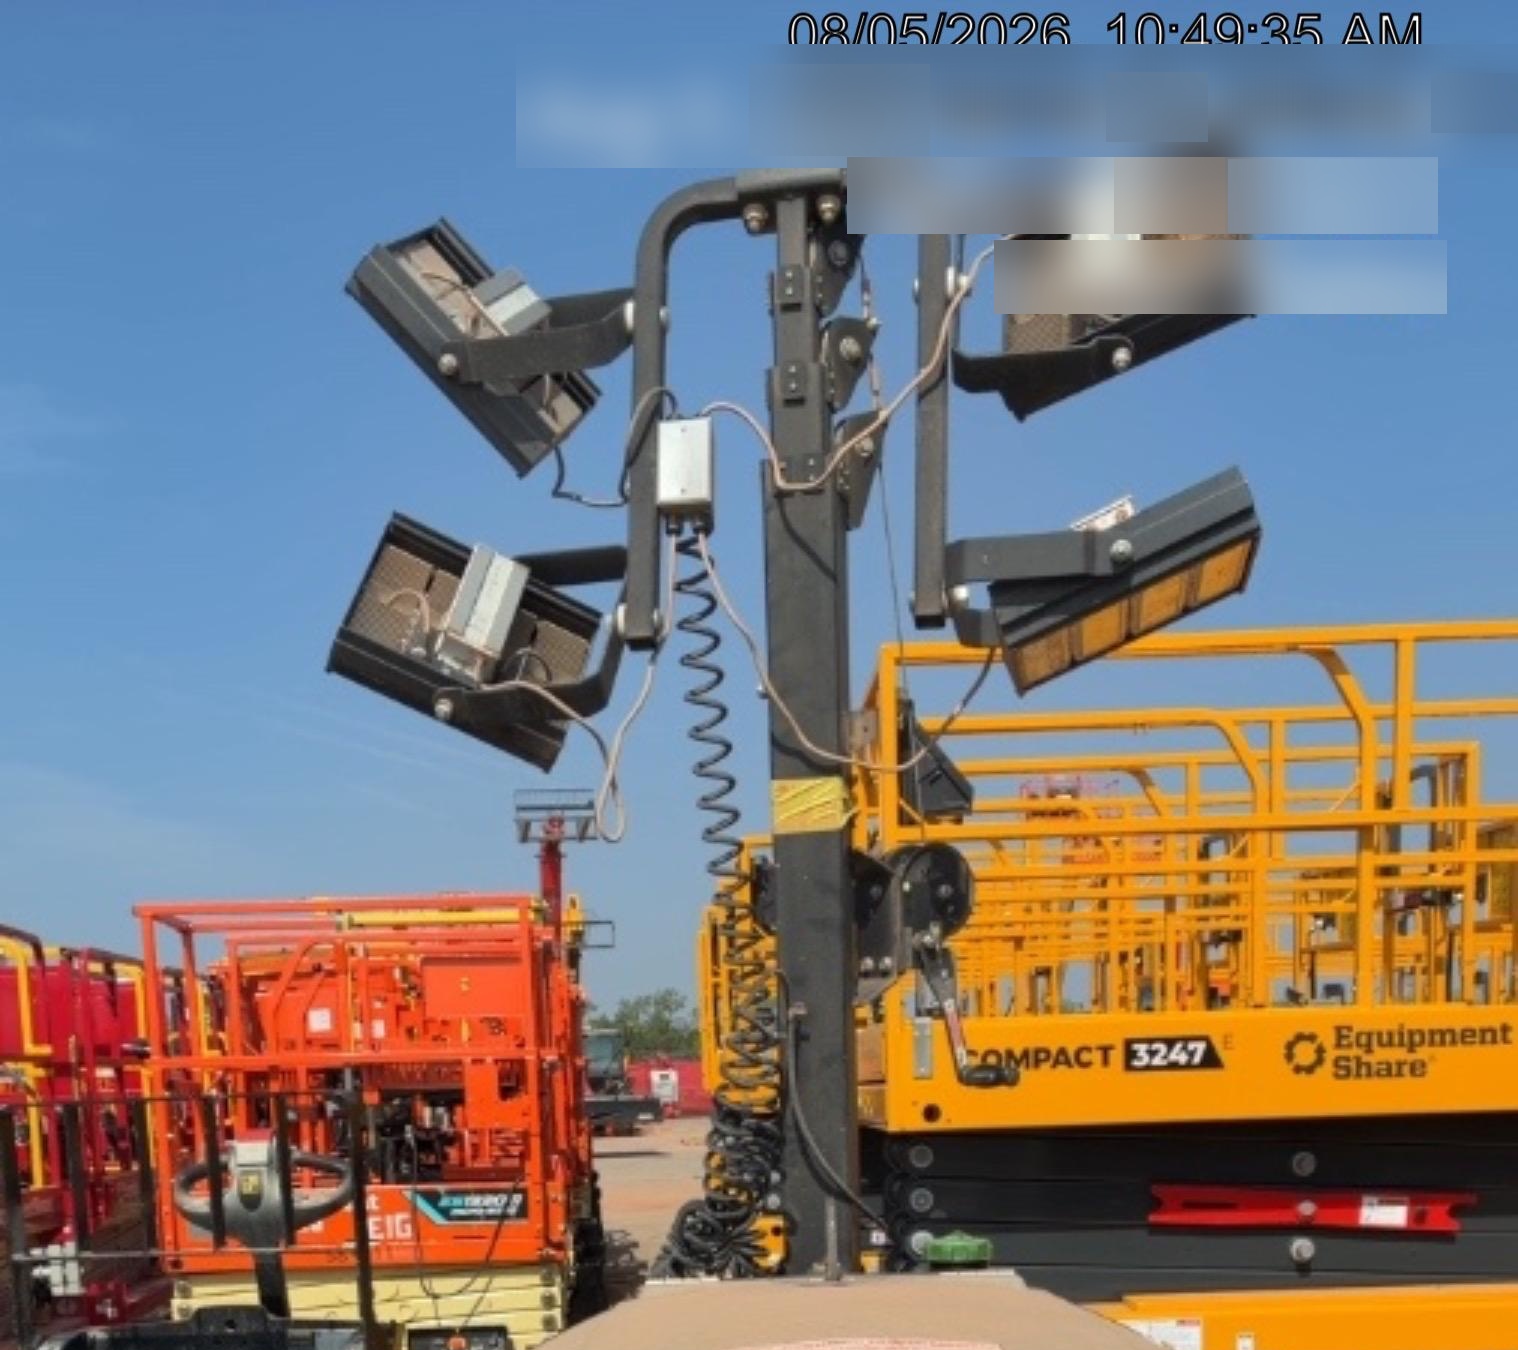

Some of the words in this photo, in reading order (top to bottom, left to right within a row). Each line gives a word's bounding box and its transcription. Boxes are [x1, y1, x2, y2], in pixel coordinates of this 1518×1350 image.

[1333, 1023, 1513, 1053] Equipment
[1130, 1039, 1208, 1067] 3247
[1332, 1055, 1428, 1080] Share
